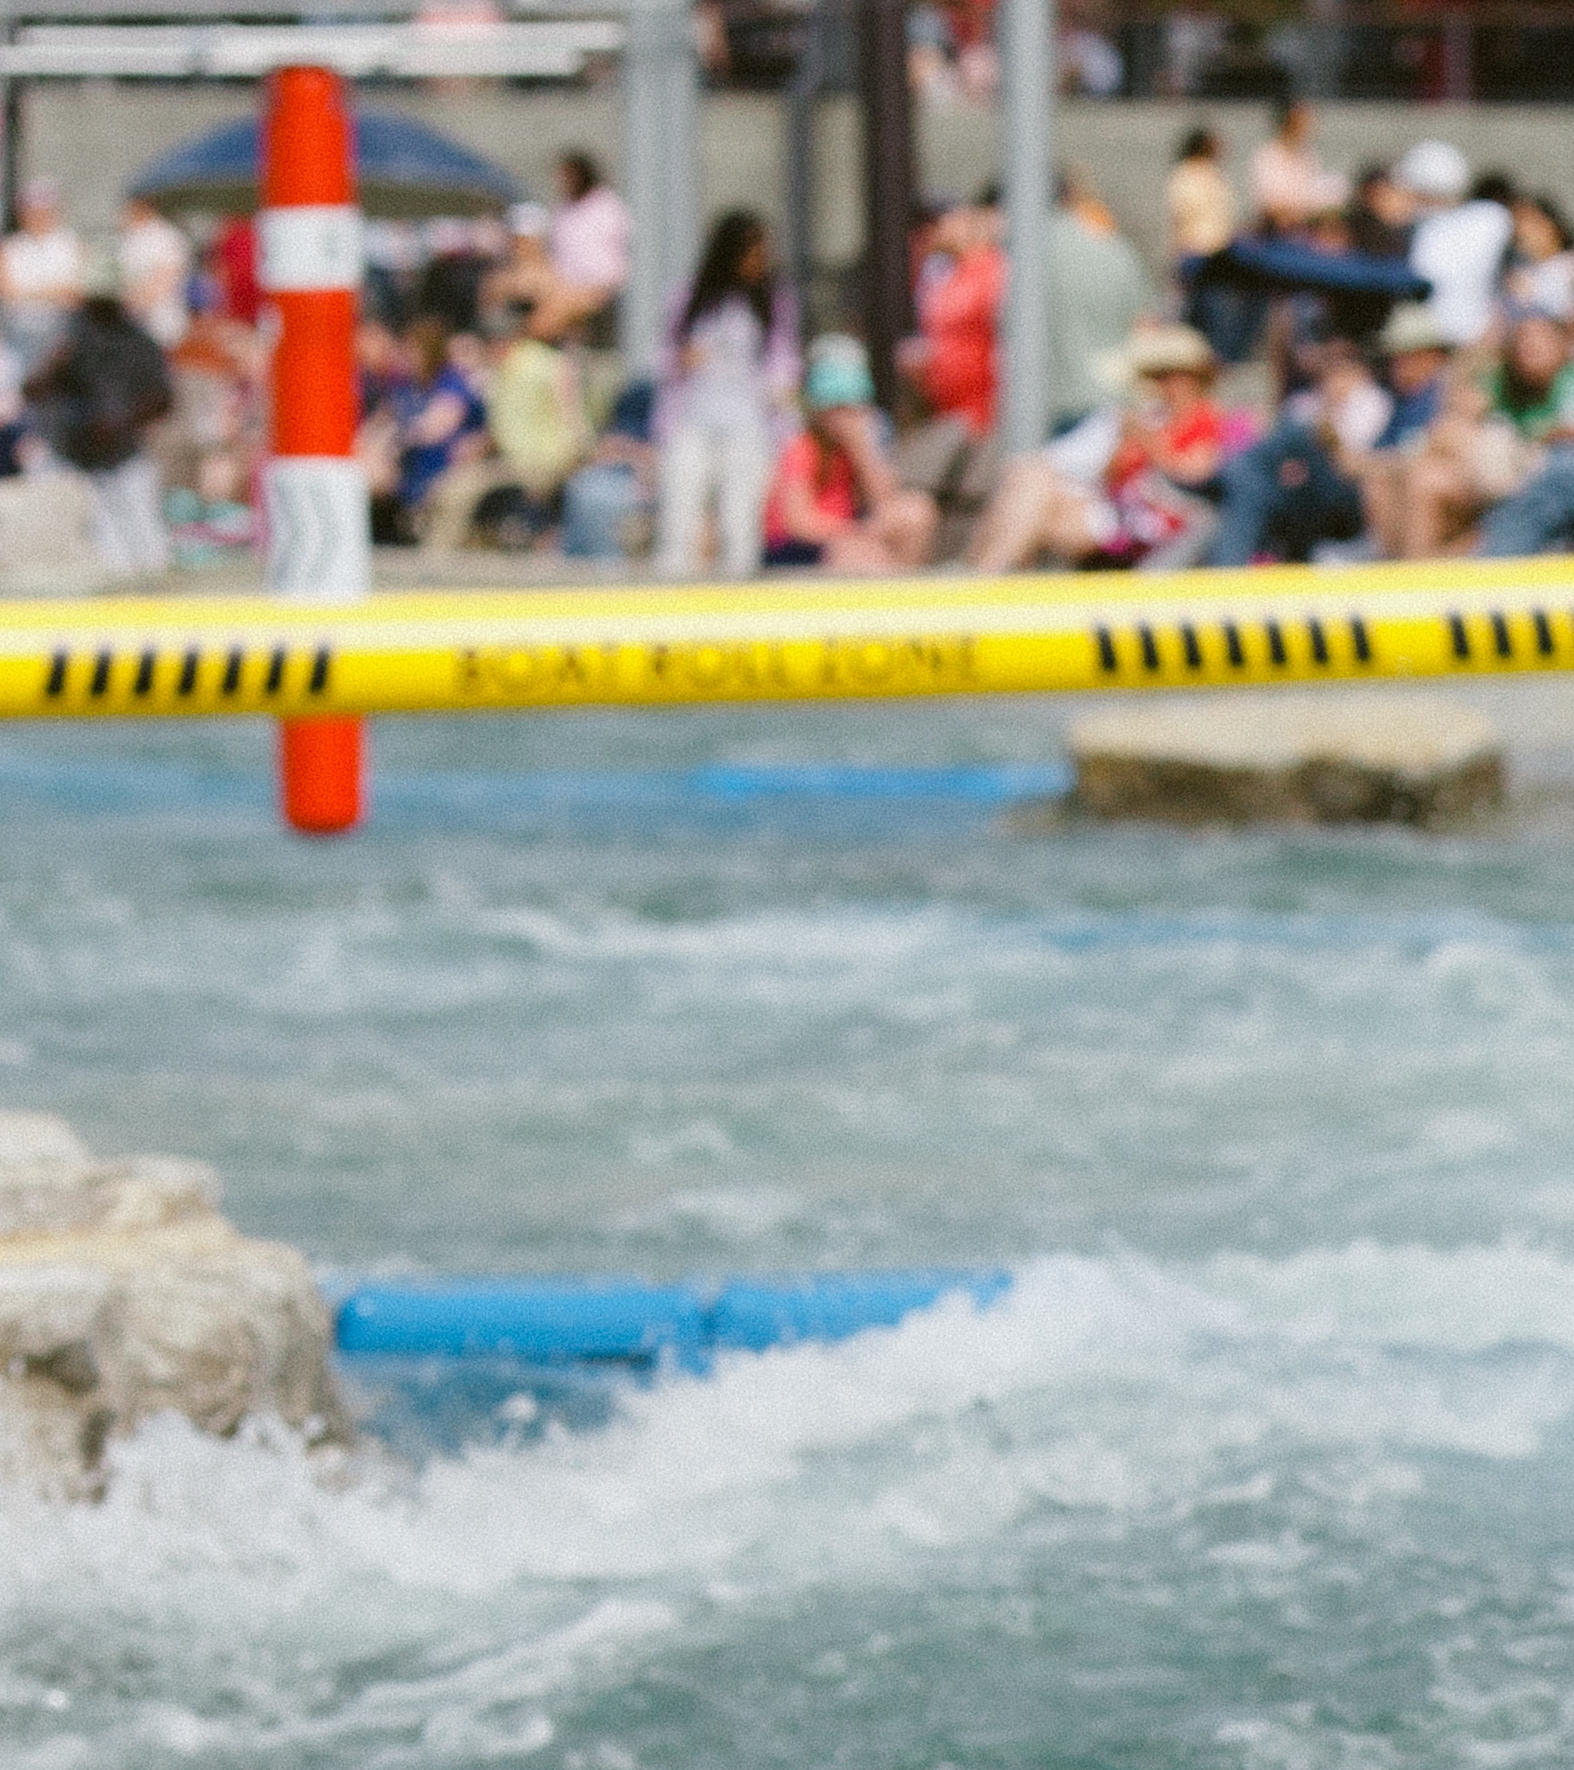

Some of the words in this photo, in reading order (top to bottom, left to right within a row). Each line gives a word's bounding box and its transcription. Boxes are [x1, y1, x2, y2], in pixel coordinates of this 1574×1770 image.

[453, 643, 620, 697] BOAT
[643, 639, 792, 695] ROLL
[817, 634, 982, 690] ZONE
